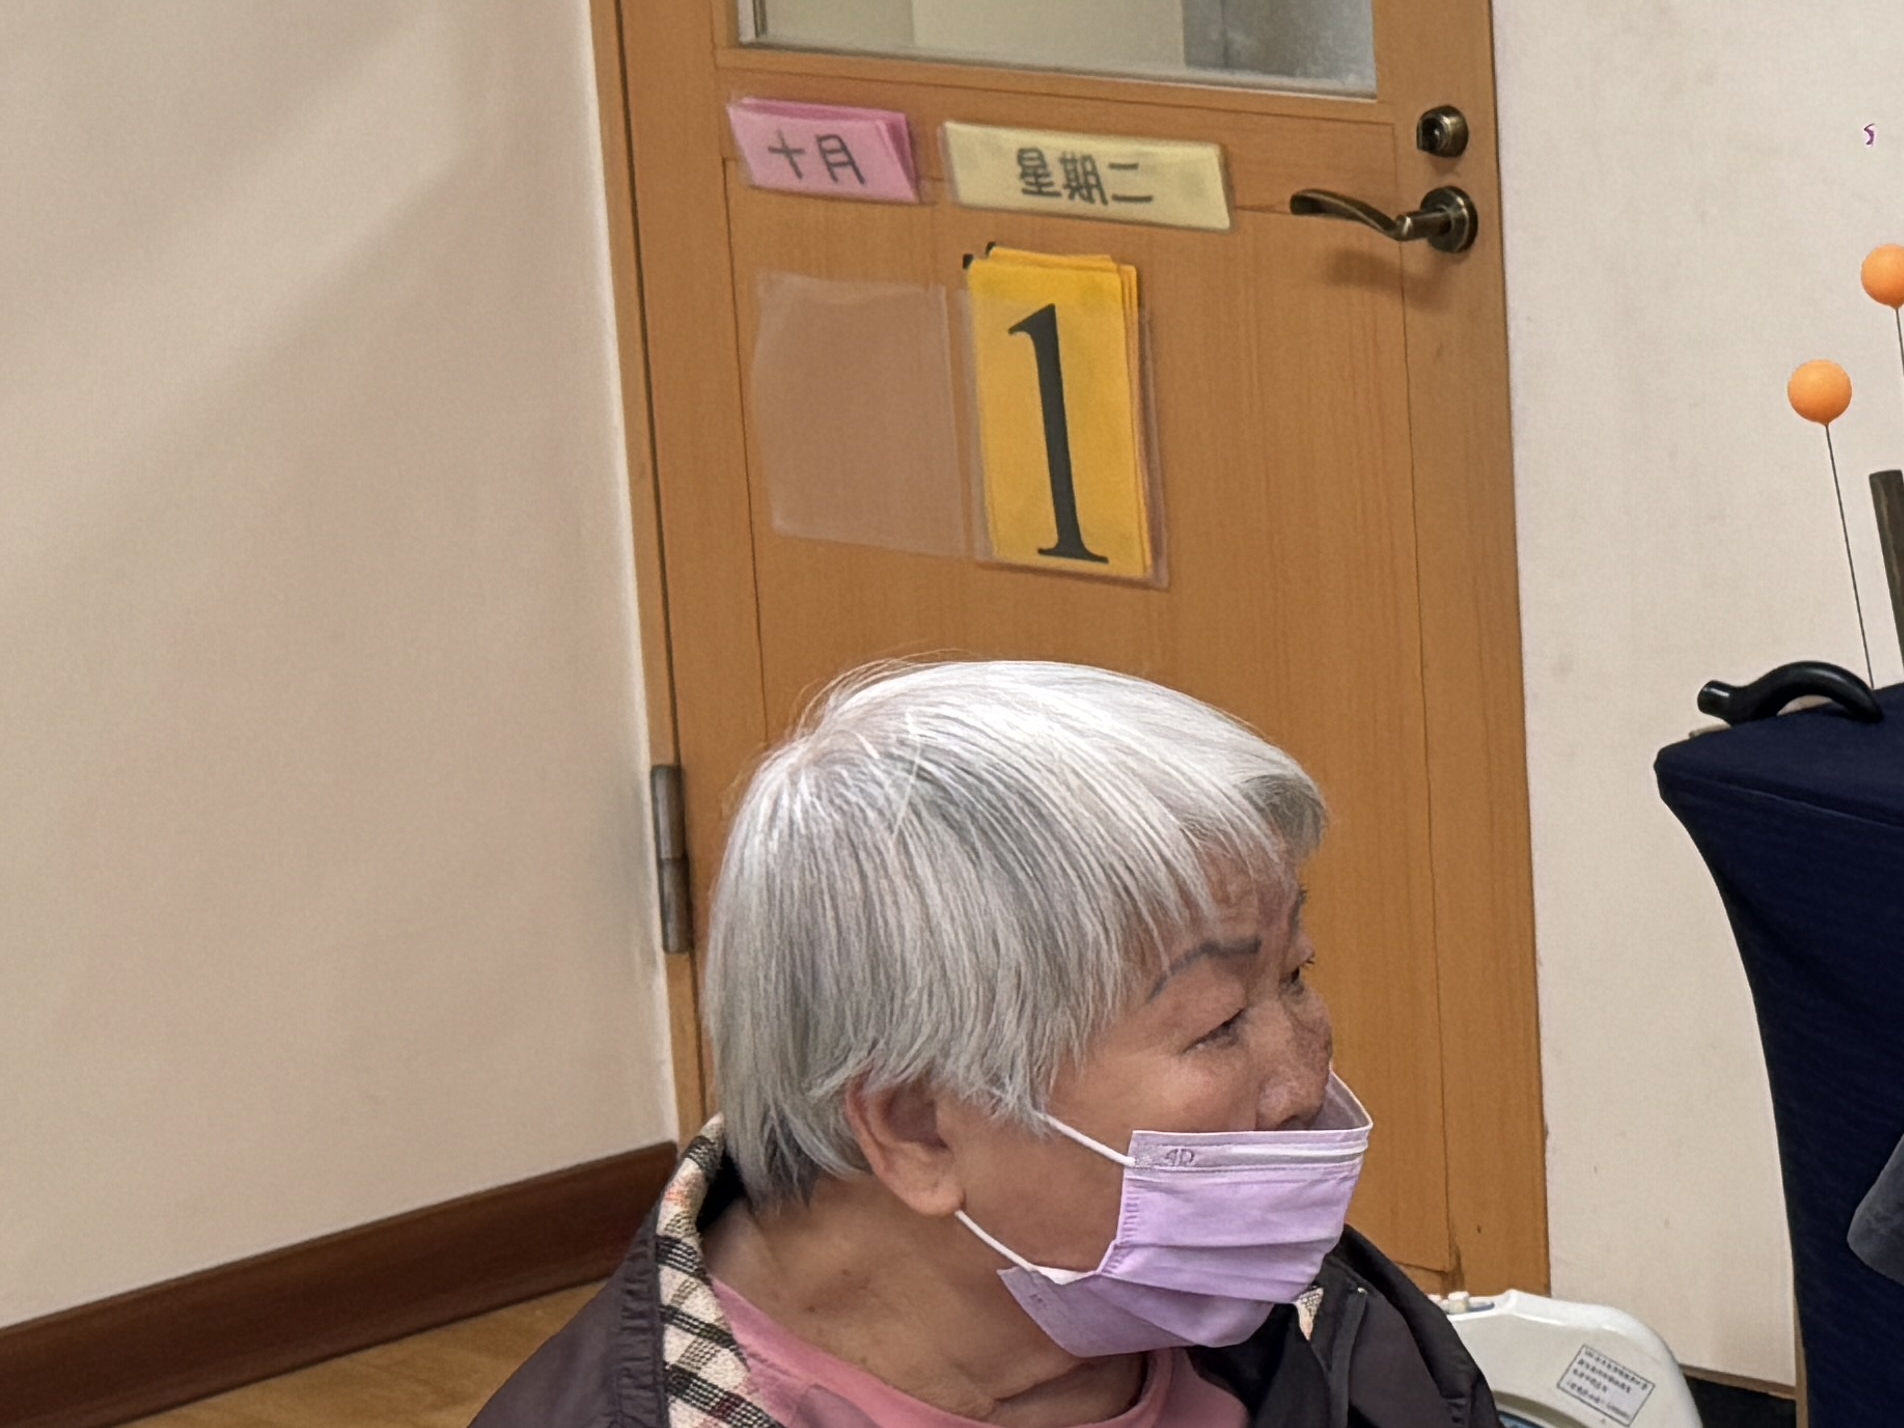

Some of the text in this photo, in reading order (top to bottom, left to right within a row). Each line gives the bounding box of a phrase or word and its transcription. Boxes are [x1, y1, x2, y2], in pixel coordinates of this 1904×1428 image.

[768, 131, 867, 186] 十月
[1015, 146, 1154, 207] 星期二
[1008, 303, 1110, 565] 1
